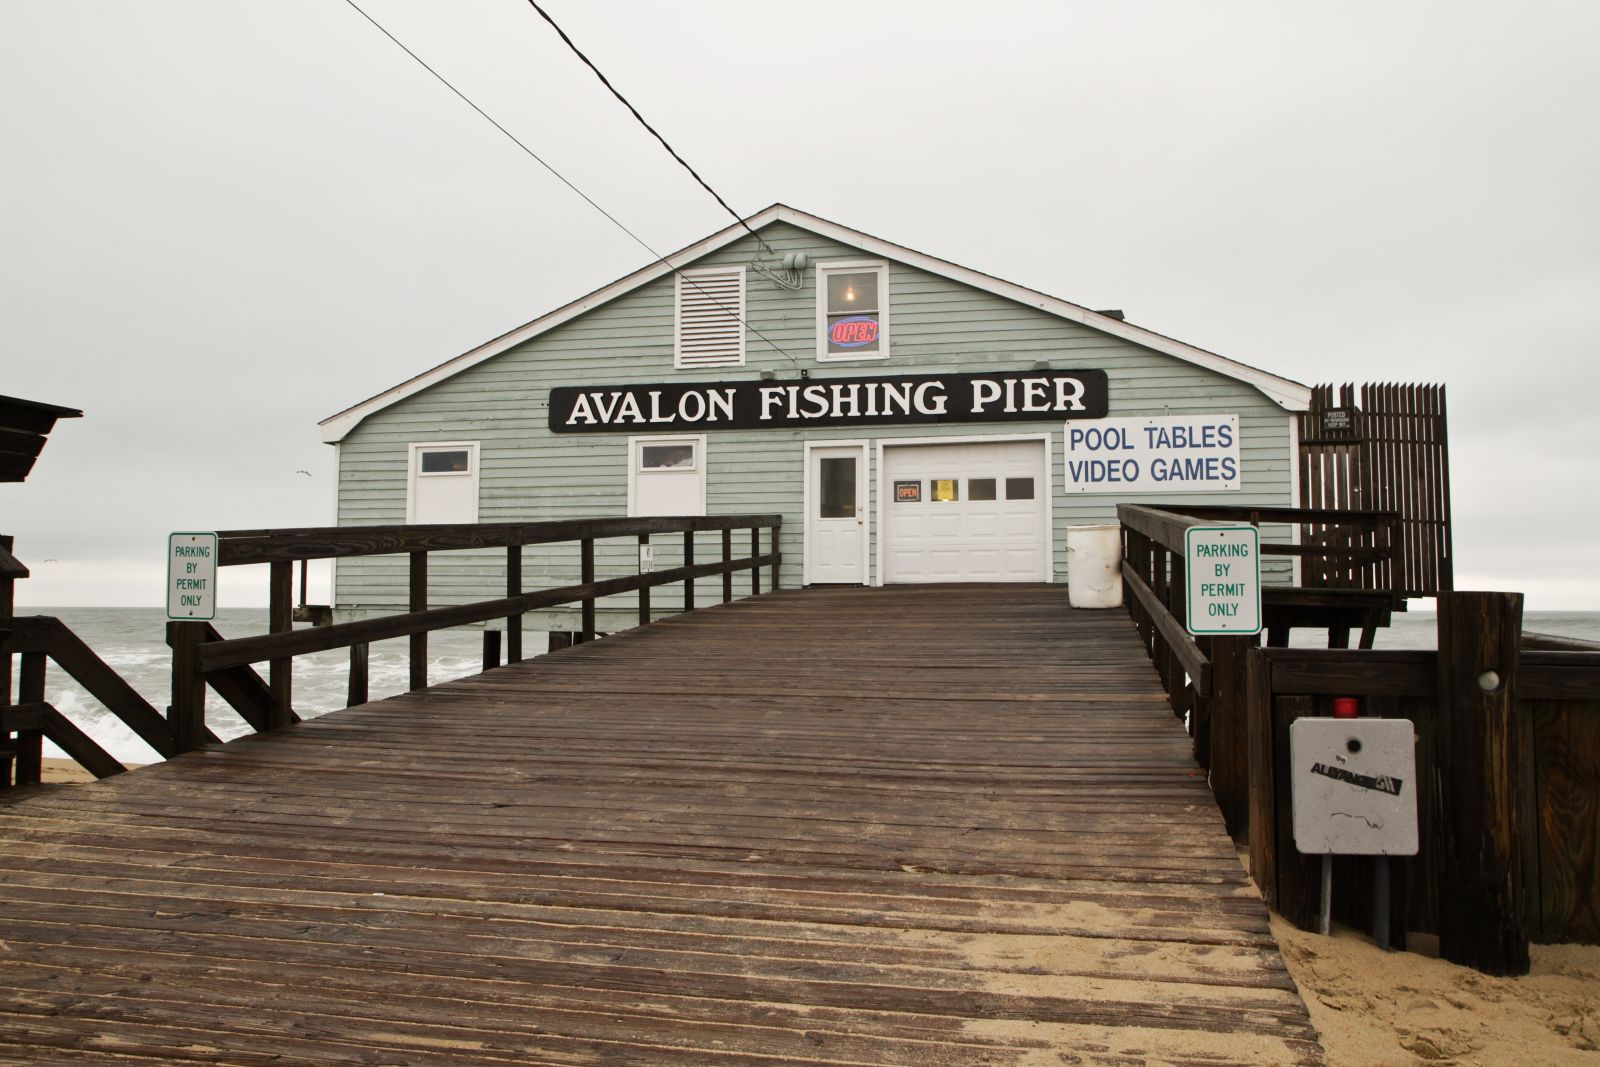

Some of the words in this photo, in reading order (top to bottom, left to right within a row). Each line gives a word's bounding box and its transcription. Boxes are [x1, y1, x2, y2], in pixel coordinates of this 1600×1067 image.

[832, 322, 878, 343] OPEN
[565, 388, 737, 425] AVALON
[758, 381, 948, 420] FISHING
[970, 377, 1087, 413] PIER
[1070, 427, 1135, 451] POOL
[1144, 424, 1233, 449] TABLES
[1069, 458, 1140, 483] VIDEO
[1150, 457, 1237, 481] GAMES
[899, 487, 917, 498] OPEN
[175, 546, 210, 558] PARKING
[1197, 544, 1249, 557] PARKING
[186, 562, 198, 574] BY
[1215, 563, 1230, 577] BY
[176, 578, 207, 590] PERMIT
[1201, 583, 1246, 597] PERMIT
[181, 594, 202, 606] ONLY
[1208, 603, 1239, 616] ONLY
